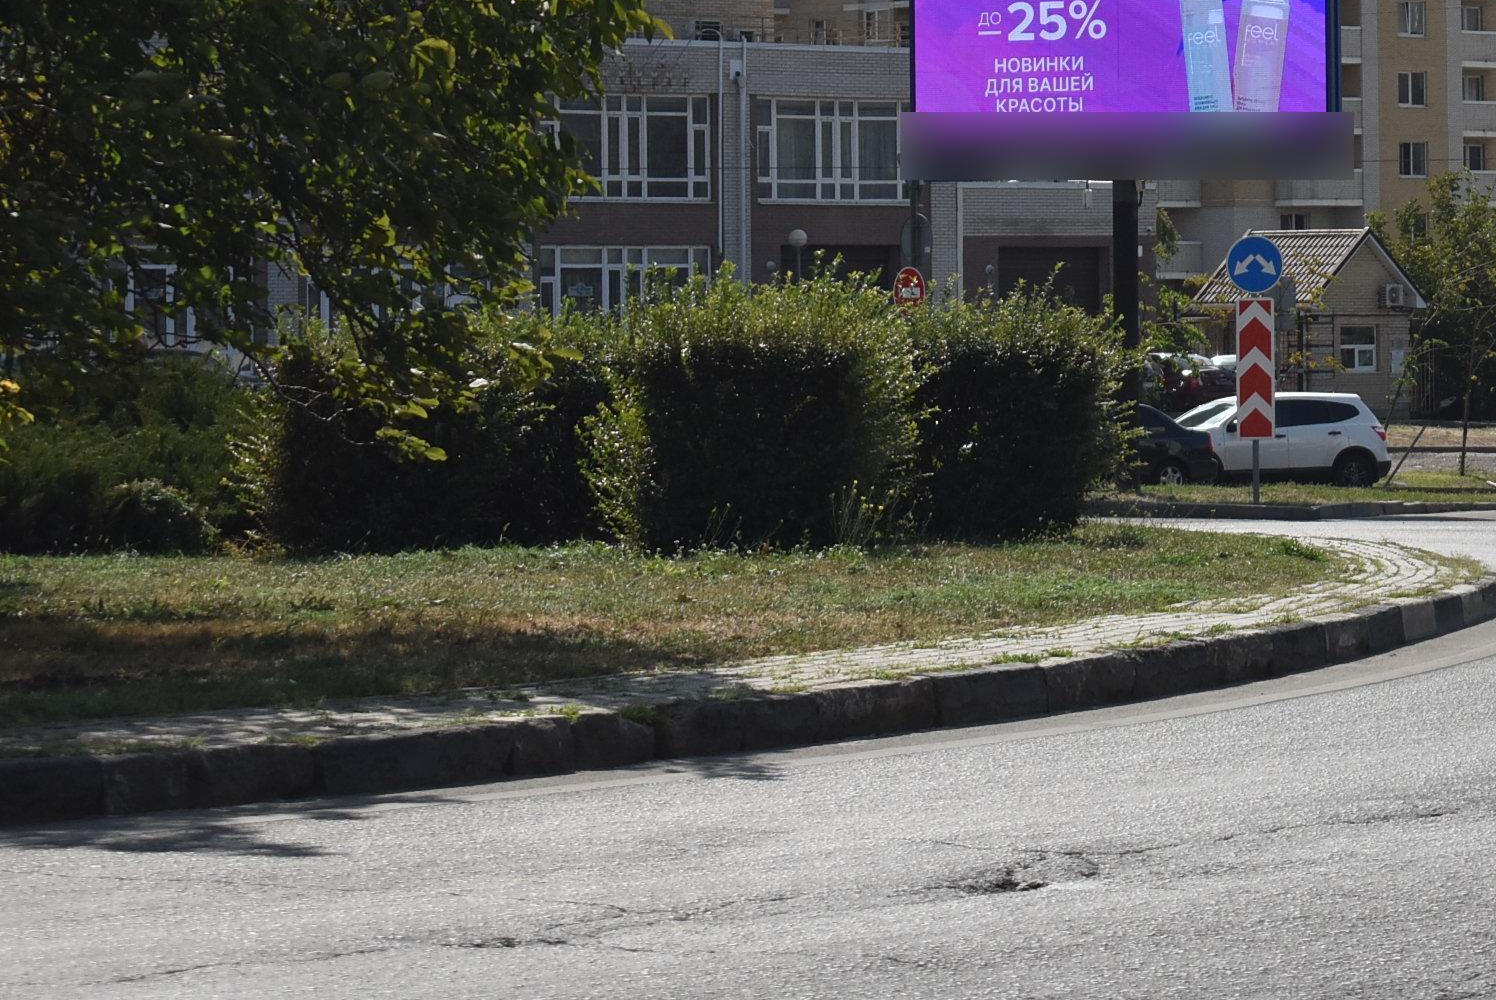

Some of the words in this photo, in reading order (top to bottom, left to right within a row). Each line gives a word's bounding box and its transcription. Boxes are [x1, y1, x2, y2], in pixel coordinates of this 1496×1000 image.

[1007, 0, 1107, 42] 25%
[994, 56, 1084, 73] НОВИНКИ
[985, 77, 1023, 97] ДЛЯ
[1028, 72, 1094, 92] ВАШЕЙ
[996, 97, 1083, 112] КРАСОТЫ
